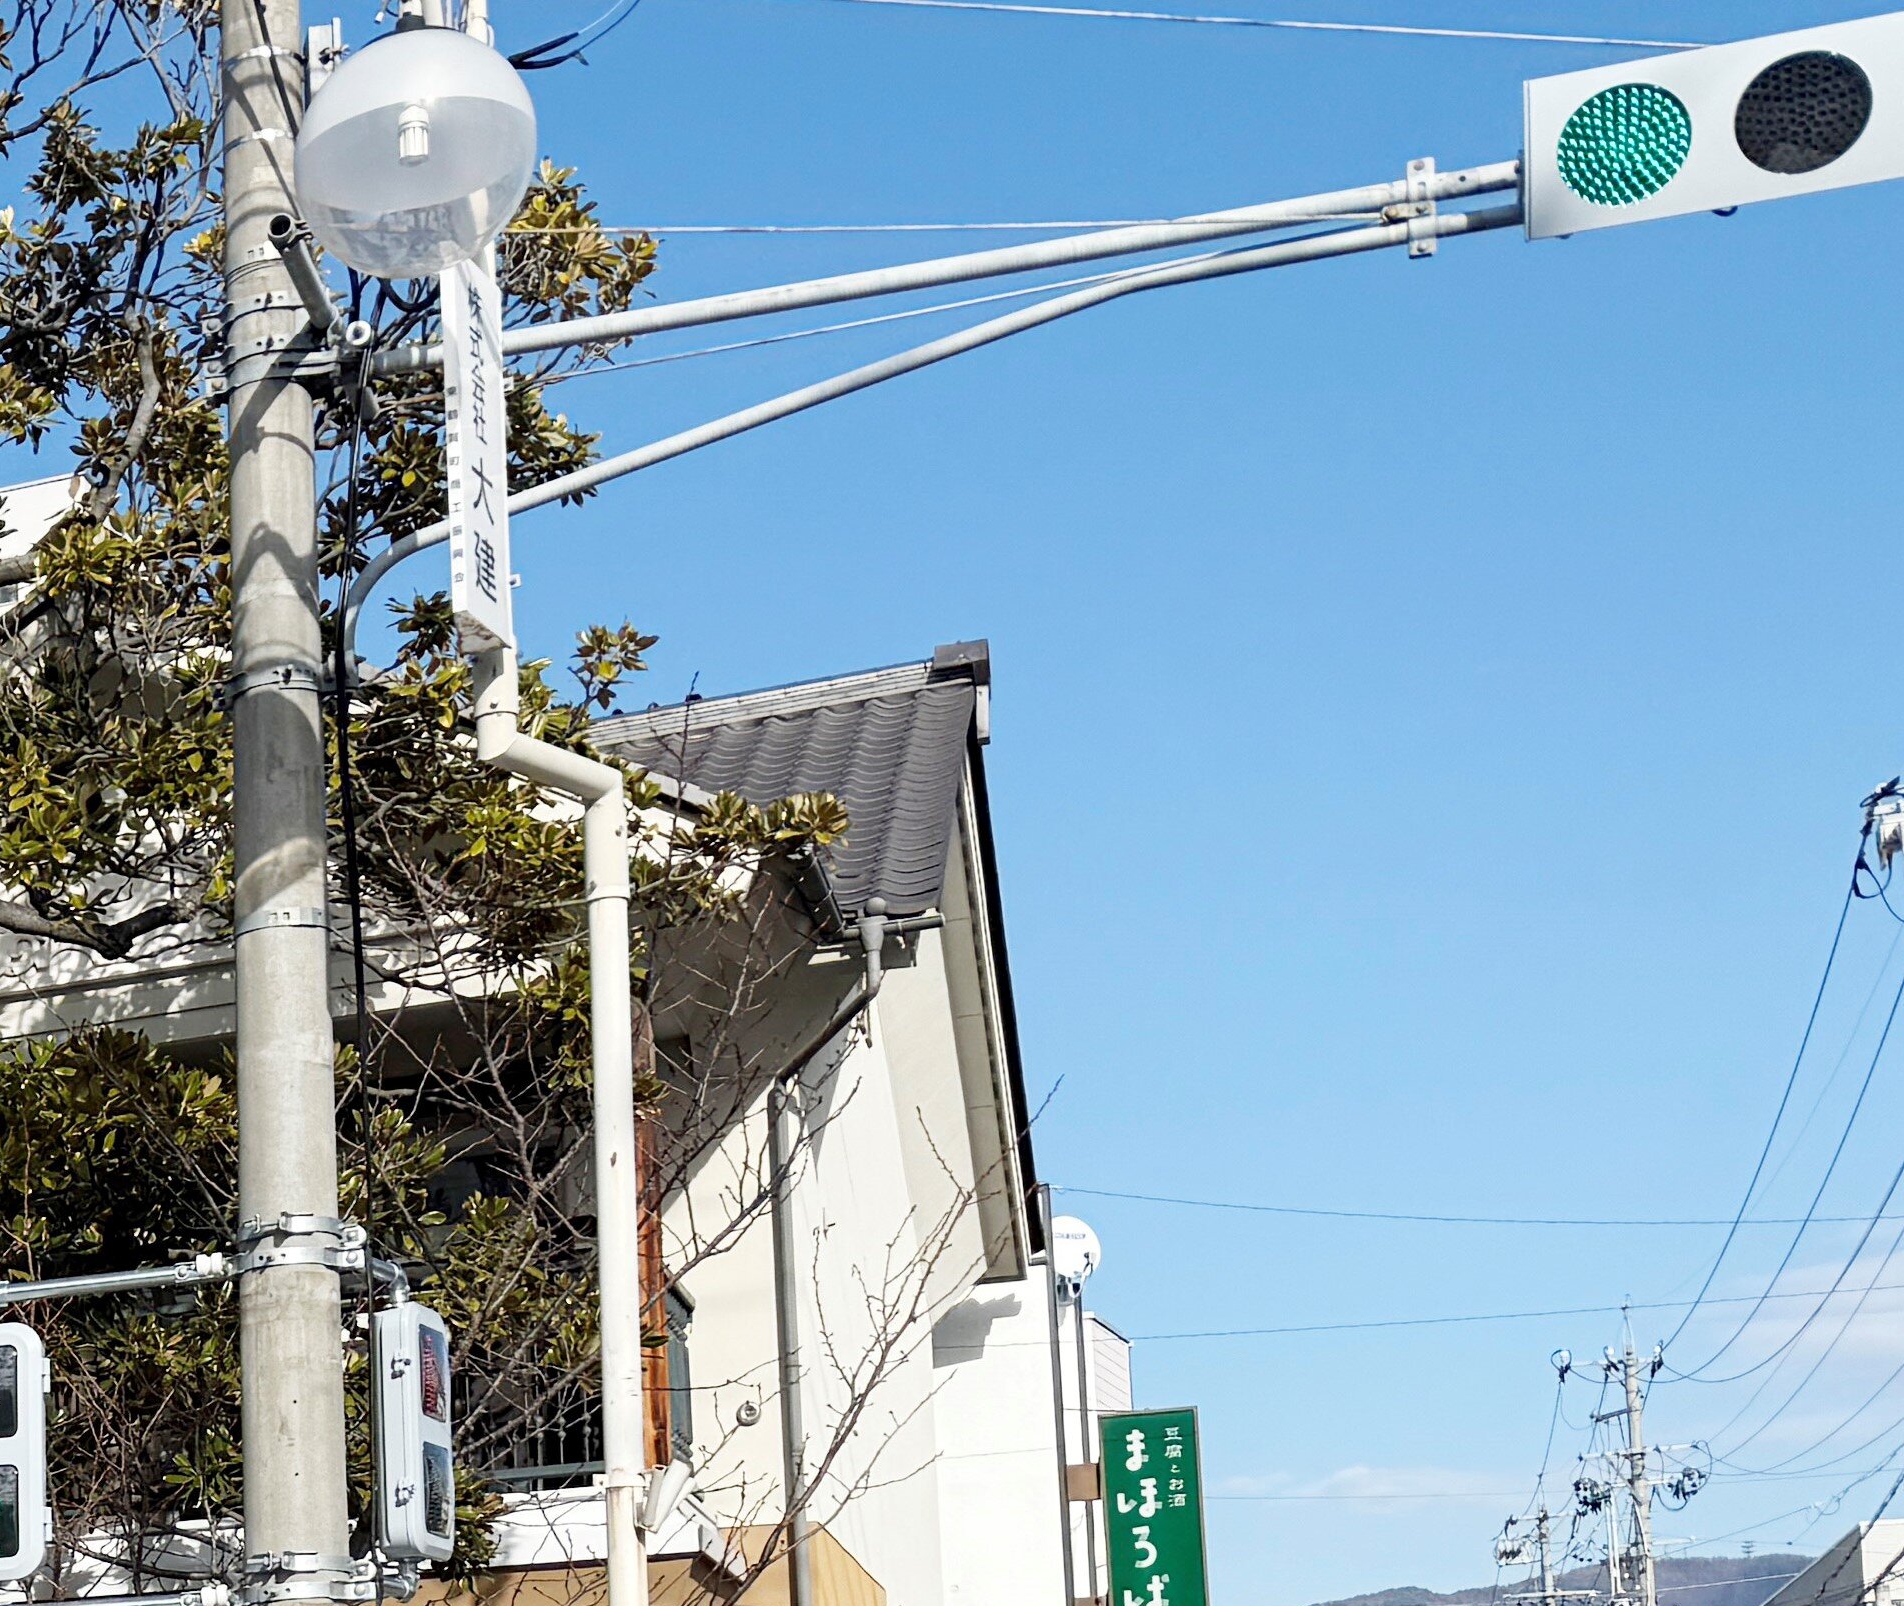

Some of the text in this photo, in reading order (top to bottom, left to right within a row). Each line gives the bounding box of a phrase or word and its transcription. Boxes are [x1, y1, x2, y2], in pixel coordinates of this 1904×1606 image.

[1163, 1426, 1186, 1508] 豆腐とお酒
